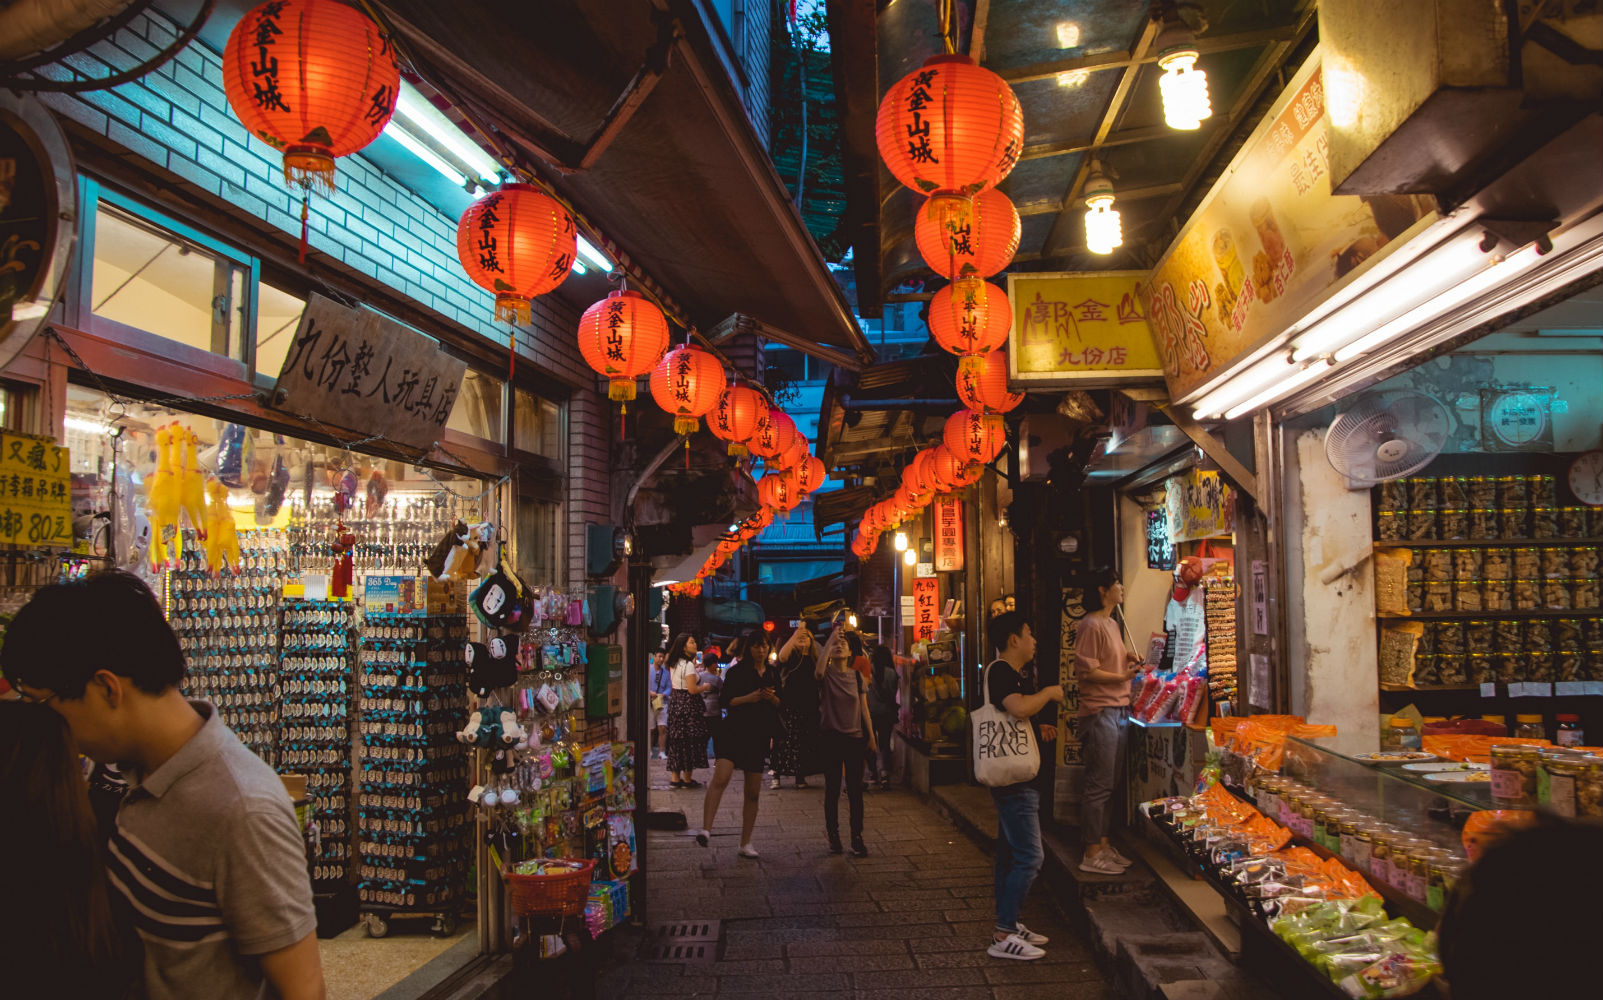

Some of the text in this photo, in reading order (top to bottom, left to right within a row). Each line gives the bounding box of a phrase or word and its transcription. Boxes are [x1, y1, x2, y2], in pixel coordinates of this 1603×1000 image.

[905, 70, 939, 164] 黃金山城
[478, 194, 505, 274] 黃金山城
[606, 302, 627, 362] 黃金山城
[284, 318, 456, 427] 九份整人玩具店
[675, 353, 692, 403] 黃金山城
[1058, 346, 1127, 366] 九份店
[1, 440, 61, 473] 又瘋了
[969, 414, 982, 455] 黃金山城
[0, 508, 73, 543] 都80元
[915, 581, 935, 592] 九份
[918, 594, 934, 639] 紅豆餅
